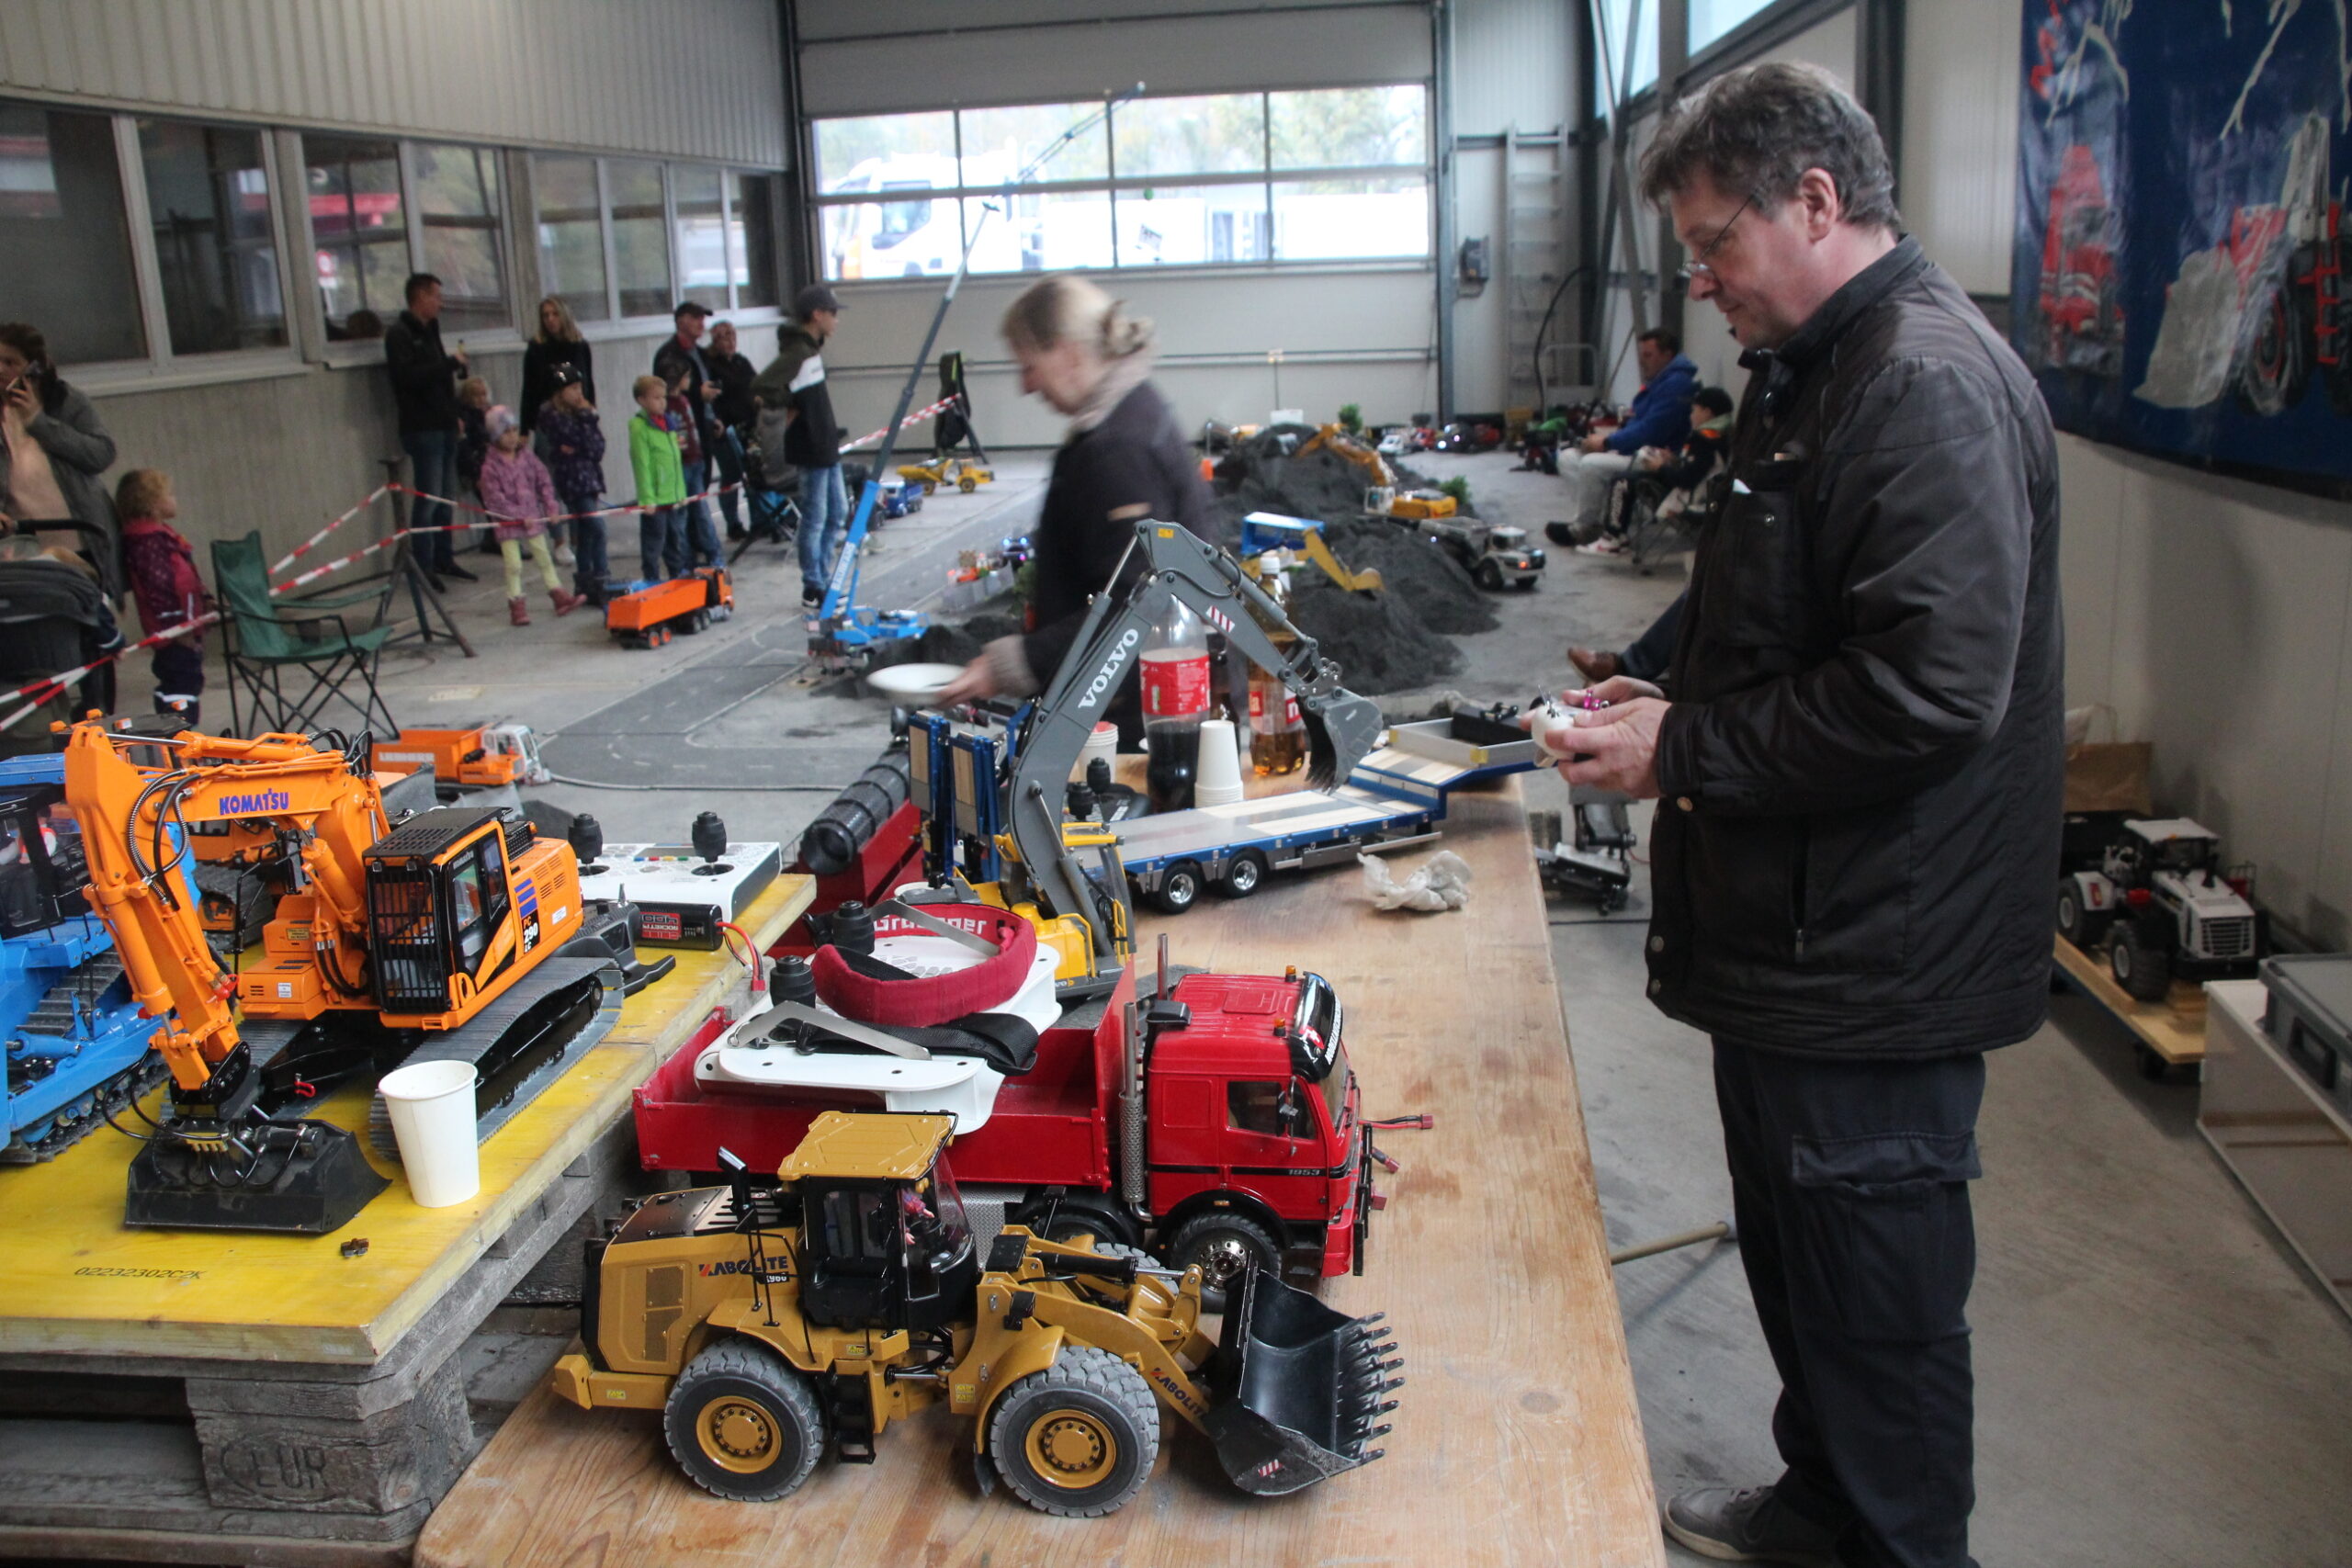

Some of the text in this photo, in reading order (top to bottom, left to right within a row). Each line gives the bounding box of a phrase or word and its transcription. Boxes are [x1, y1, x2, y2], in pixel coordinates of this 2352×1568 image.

[1078, 628, 1138, 708] VOLVO
[219, 788, 289, 815] KOMATSU
[524, 922, 538, 943] 290
[74, 1267, 207, 1280] 02232302C2K
[251, 1446, 330, 1489] EUR
